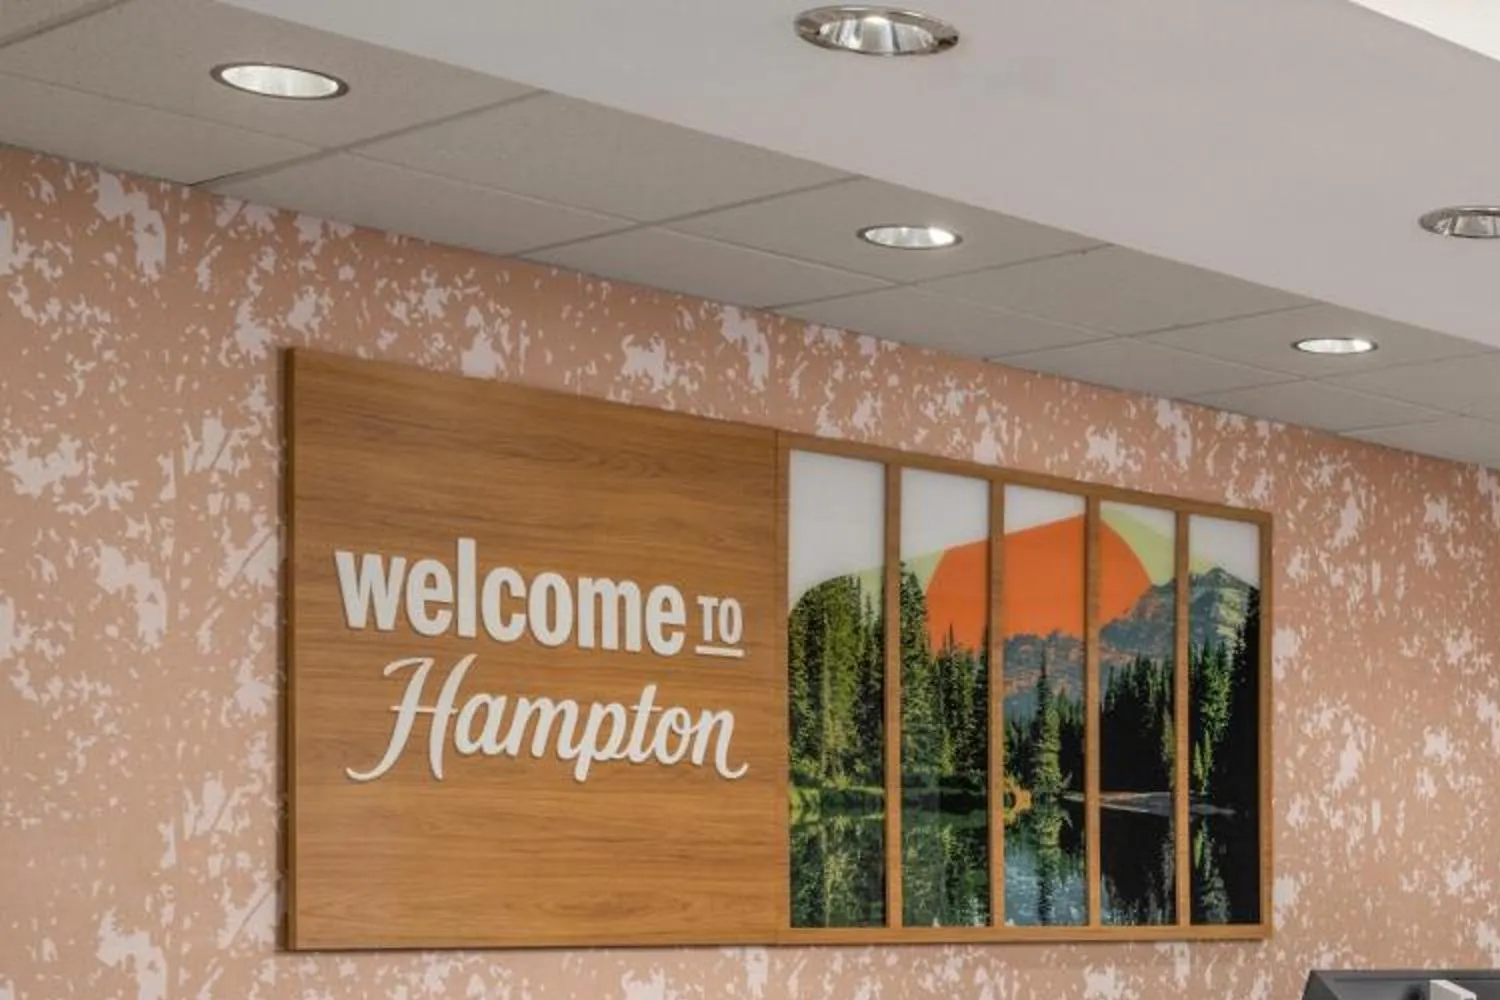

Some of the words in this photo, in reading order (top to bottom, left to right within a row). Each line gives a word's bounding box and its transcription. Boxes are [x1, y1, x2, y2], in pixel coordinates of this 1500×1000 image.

[334, 537, 687, 657] welcome
[696, 595, 745, 657] TO
[345, 653, 749, 783] Hampton
